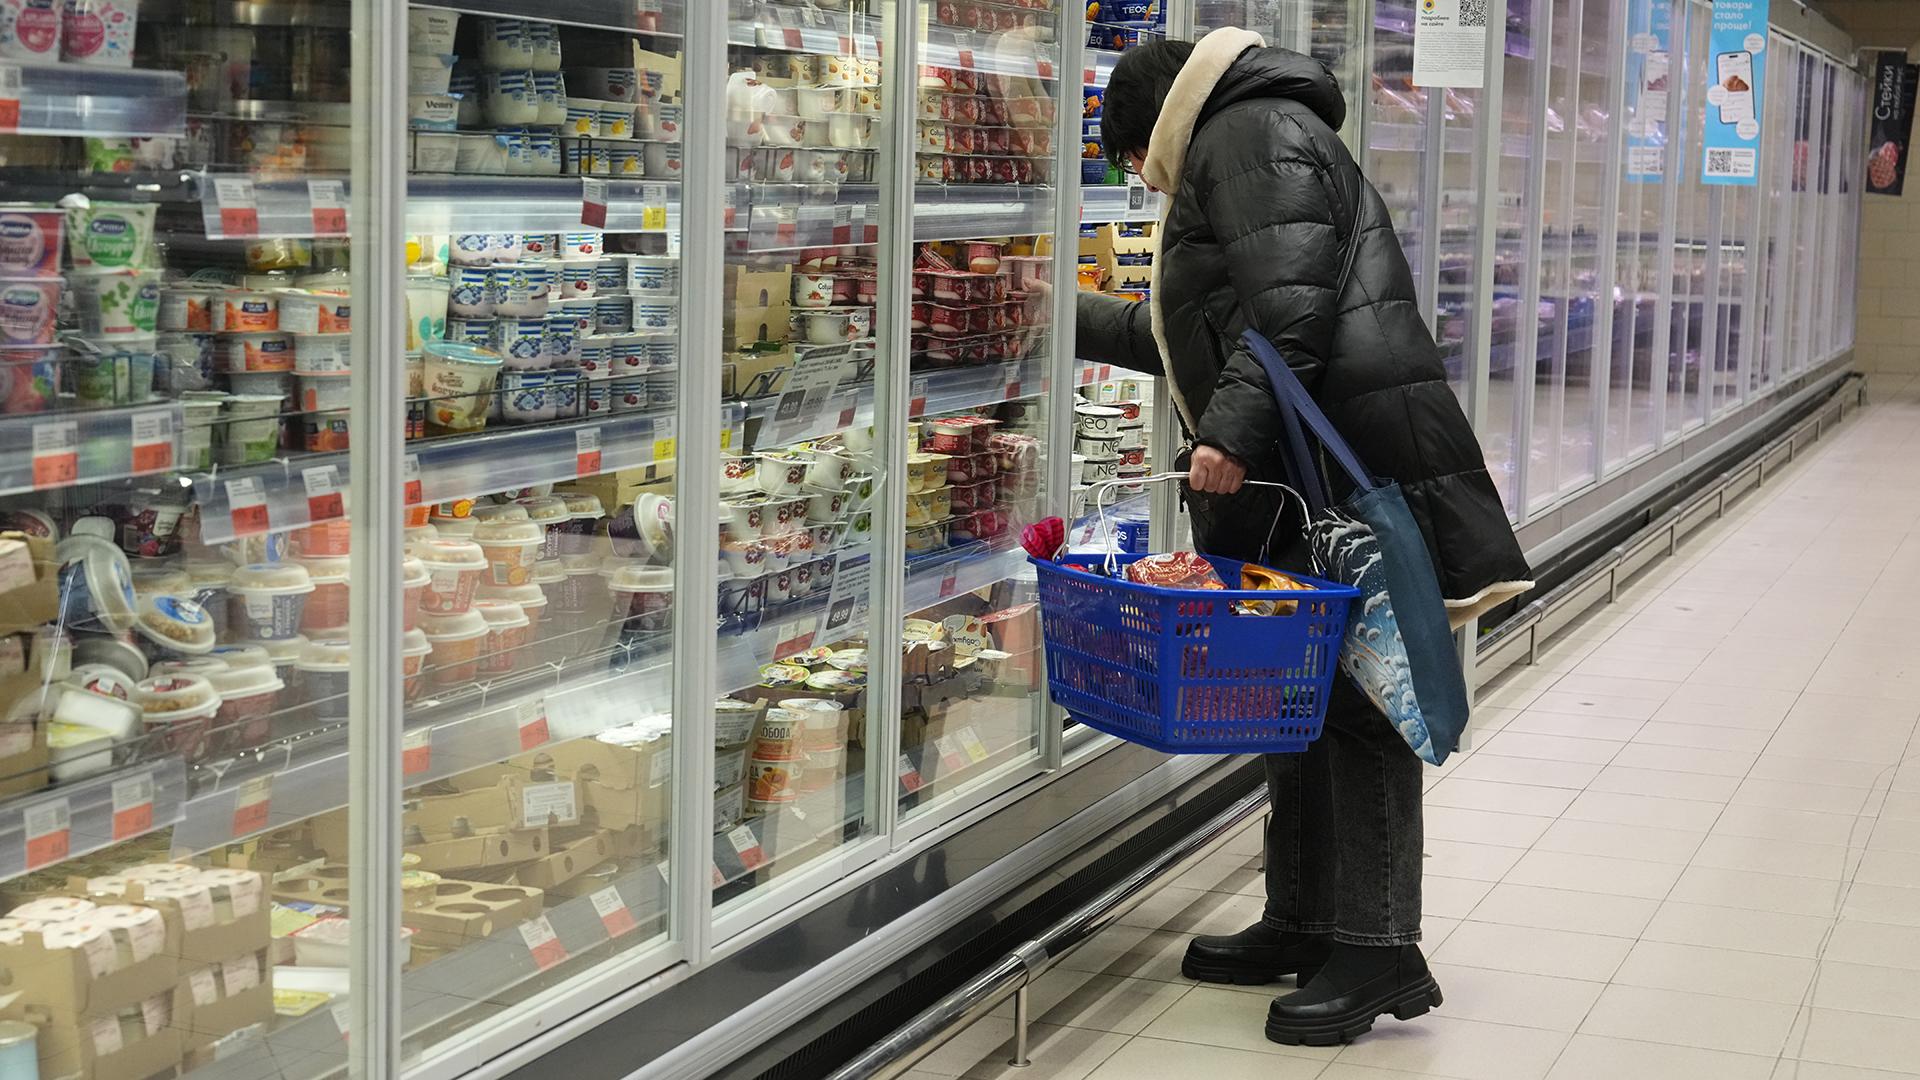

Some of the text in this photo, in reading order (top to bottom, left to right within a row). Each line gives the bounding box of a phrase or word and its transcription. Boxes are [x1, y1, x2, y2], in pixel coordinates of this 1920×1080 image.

[1122, 6, 1147, 14] TEOS
[1714, 12, 1744, 20] стало
[1714, 22, 1752, 32] проще!
[1875, 65, 1894, 120] Стейки
[1101, 440, 1120, 453] Ne
[1097, 463, 1118, 476] Ne
